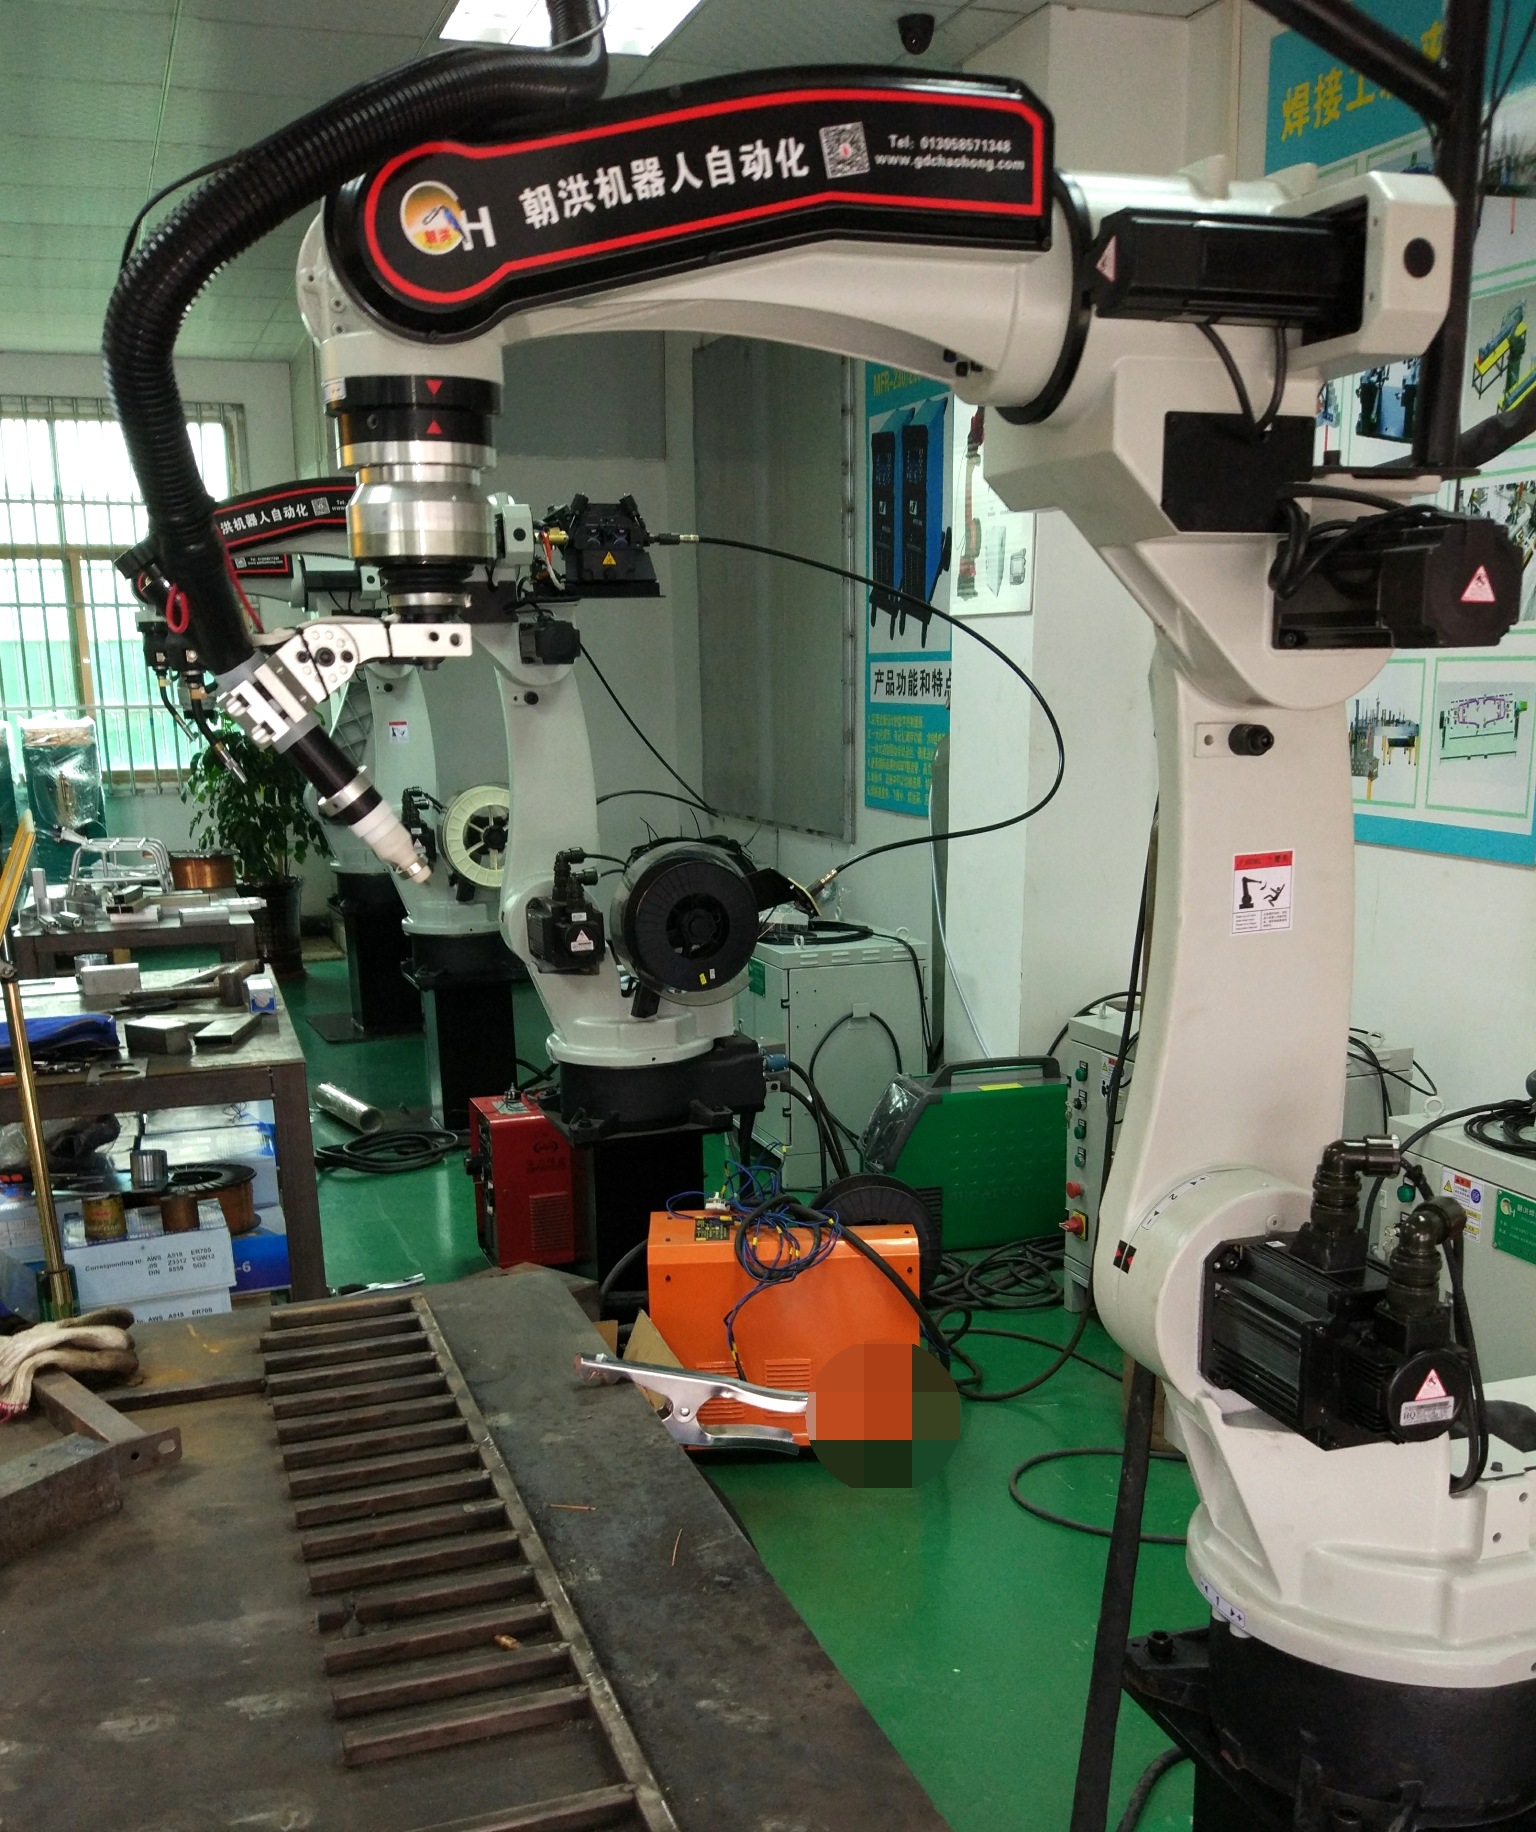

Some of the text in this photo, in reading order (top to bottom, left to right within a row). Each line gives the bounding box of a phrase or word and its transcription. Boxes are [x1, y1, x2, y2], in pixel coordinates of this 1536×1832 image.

[518, 136, 810, 230] 朝洪机器人自动化
[220, 503, 309, 535] 洪机器人自动化
[873, 668, 952, 699] 产品功能和特点
[85, 1259, 134, 1272] Corresponding
